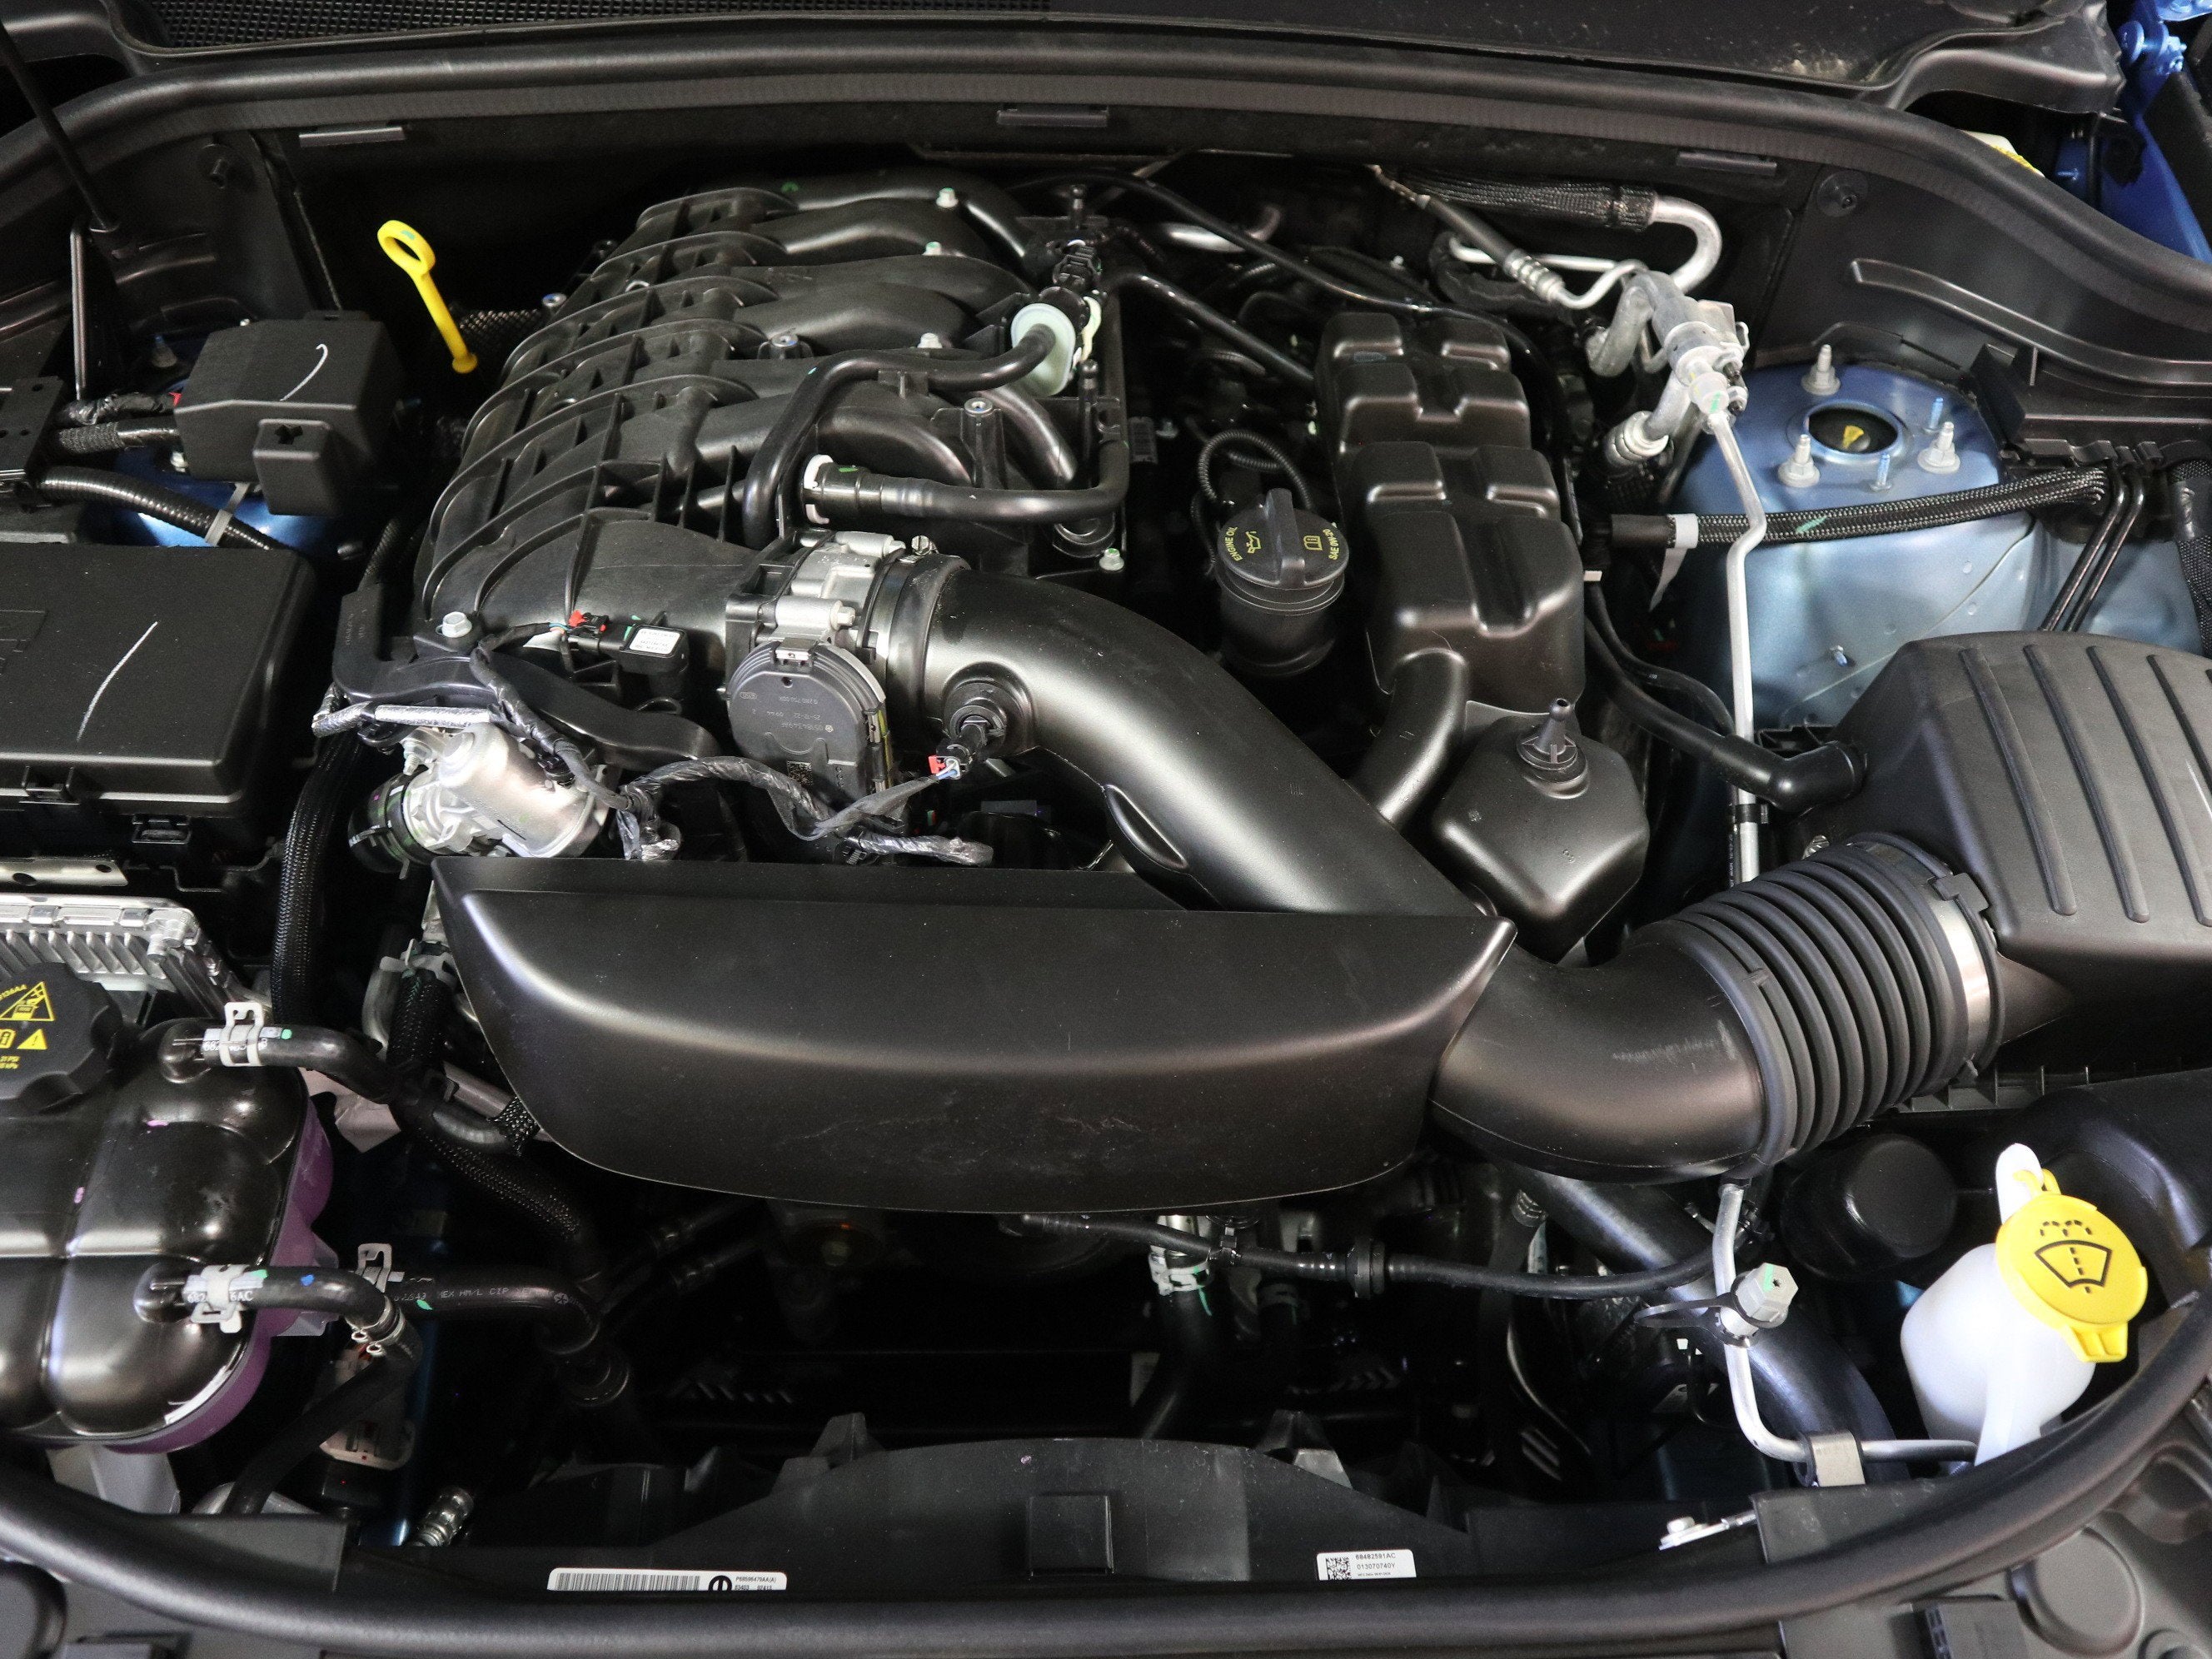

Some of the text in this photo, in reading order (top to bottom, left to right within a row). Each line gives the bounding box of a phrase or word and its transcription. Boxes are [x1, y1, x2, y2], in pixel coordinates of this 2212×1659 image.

[1225, 526, 1243, 561] ENGINE OIL
[1323, 529, 1339, 560] SAE 0W-20
